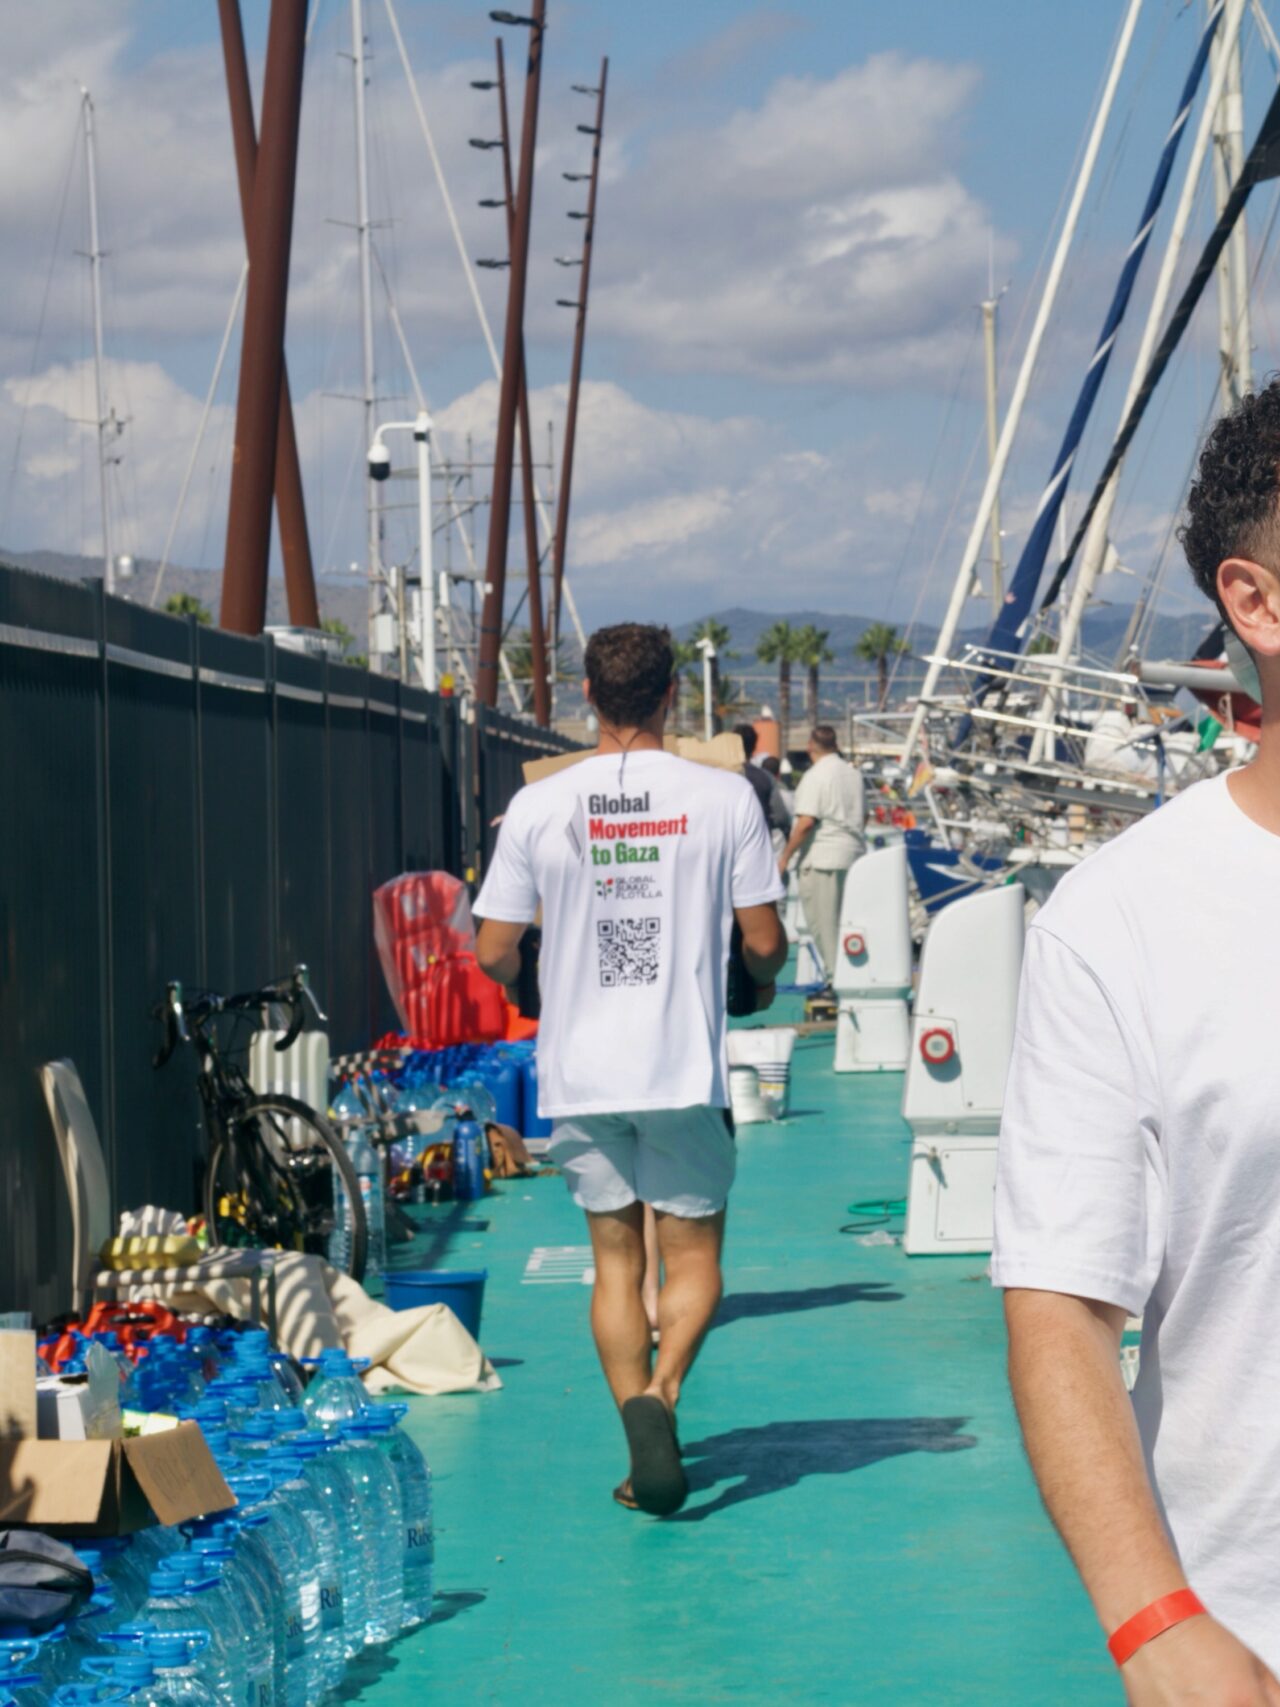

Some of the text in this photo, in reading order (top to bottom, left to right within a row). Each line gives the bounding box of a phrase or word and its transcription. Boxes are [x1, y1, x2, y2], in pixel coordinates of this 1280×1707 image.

[588, 791, 650, 815] Global
[589, 814, 688, 840] Movement
[591, 842, 660, 866] to Gaza
